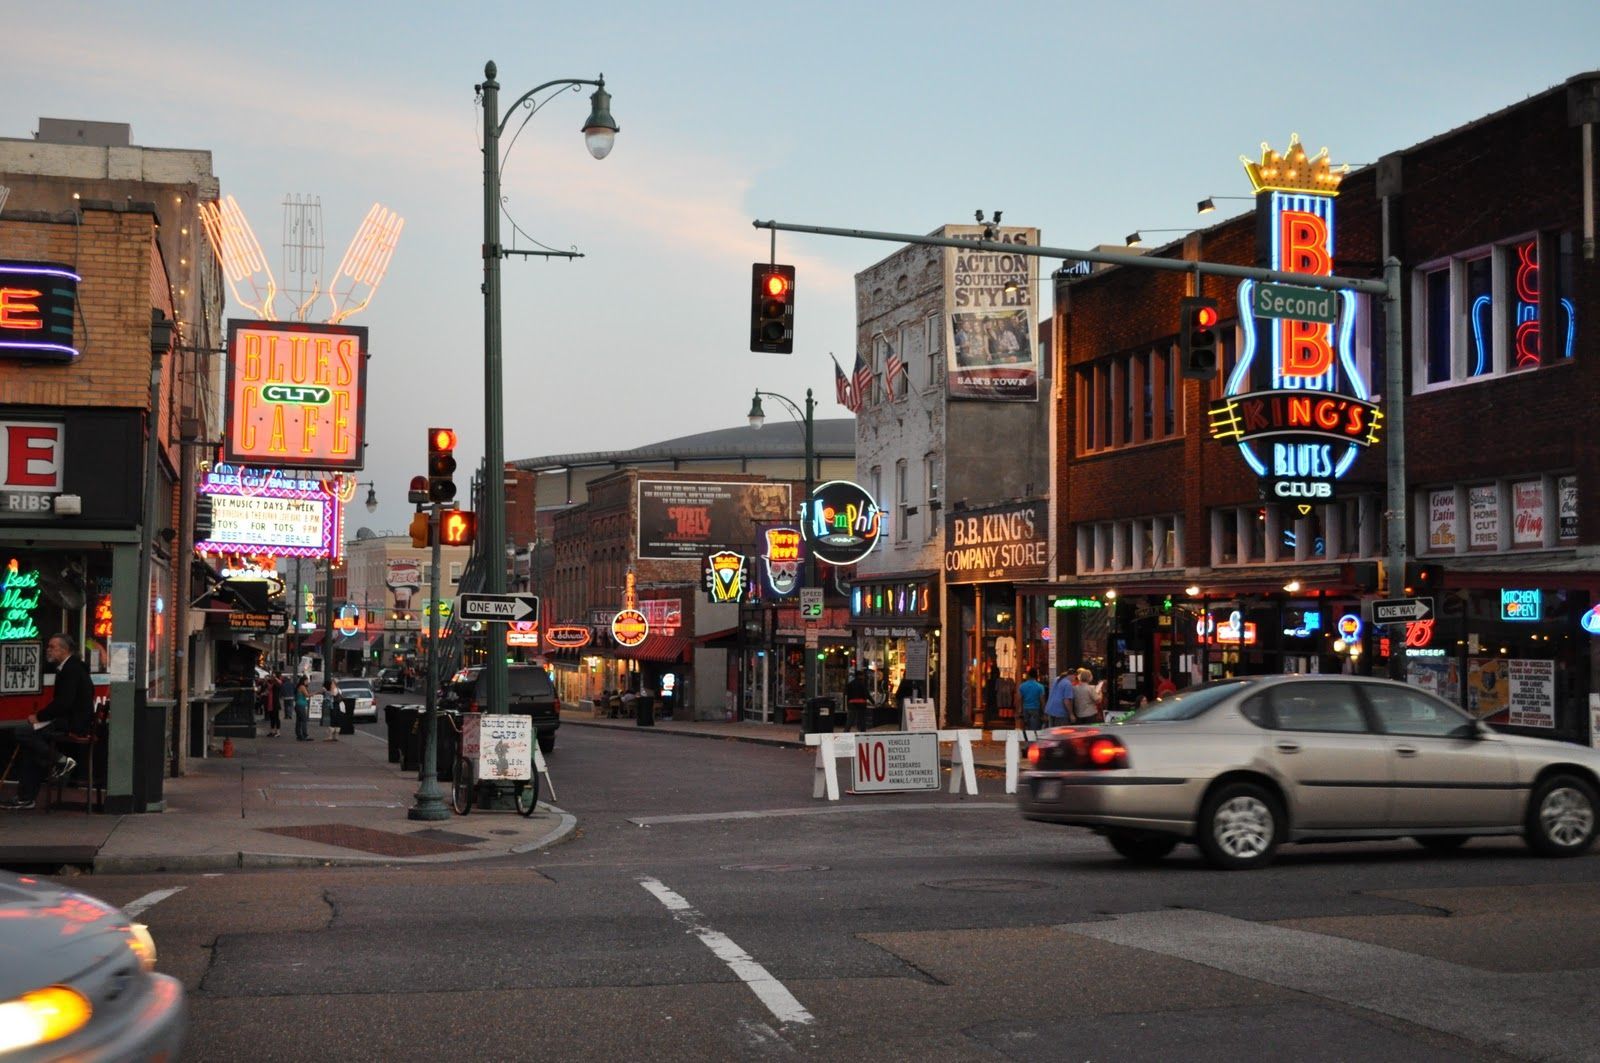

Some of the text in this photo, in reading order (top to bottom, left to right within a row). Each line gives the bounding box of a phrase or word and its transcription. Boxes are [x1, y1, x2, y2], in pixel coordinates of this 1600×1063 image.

[955, 255, 1028, 274] ACTION
[955, 274, 1029, 286] SOUTHERN
[955, 287, 1031, 306] STYLE
[1260, 288, 1328, 317] Second
[242, 334, 354, 386] BLUES
[957, 377, 1027, 386] SAM'S TOWN
[1243, 397, 1364, 434] KING'S
[1274, 443, 1331, 477] BLUES
[1274, 482, 1332, 497] CLUB
[9, 494, 52, 512] RIBS
[213, 498, 226, 507] IVE
[229, 499, 253, 509] MUSIC
[256, 501, 260, 509] 7
[263, 502, 284, 511] DAYS
[295, 503, 315, 513] WEEK
[218, 520, 239, 530] TOYS
[250, 523, 266, 532] FOR
[274, 523, 295, 533] TOTS
[954, 508, 1035, 546] B.B. KING'S
[1475, 520, 1497, 530] CUT
[1474, 532, 1498, 542] FRIES
[945, 541, 1046, 571] COMPANY STORE
[1503, 590, 1538, 604] KITCHEN
[469, 602, 516, 614] ONE WAY
[802, 604, 821, 616] 25
[1379, 605, 1417, 617] ONE WAY
[1508, 603, 1535, 617] OPEN
[4, 646, 37, 666] BLUES
[1406, 648, 1446, 656] DWEISER
[506, 720, 528, 729] CITY
[858, 742, 886, 782] NO
[904, 769, 933, 777] CONTAINERS
